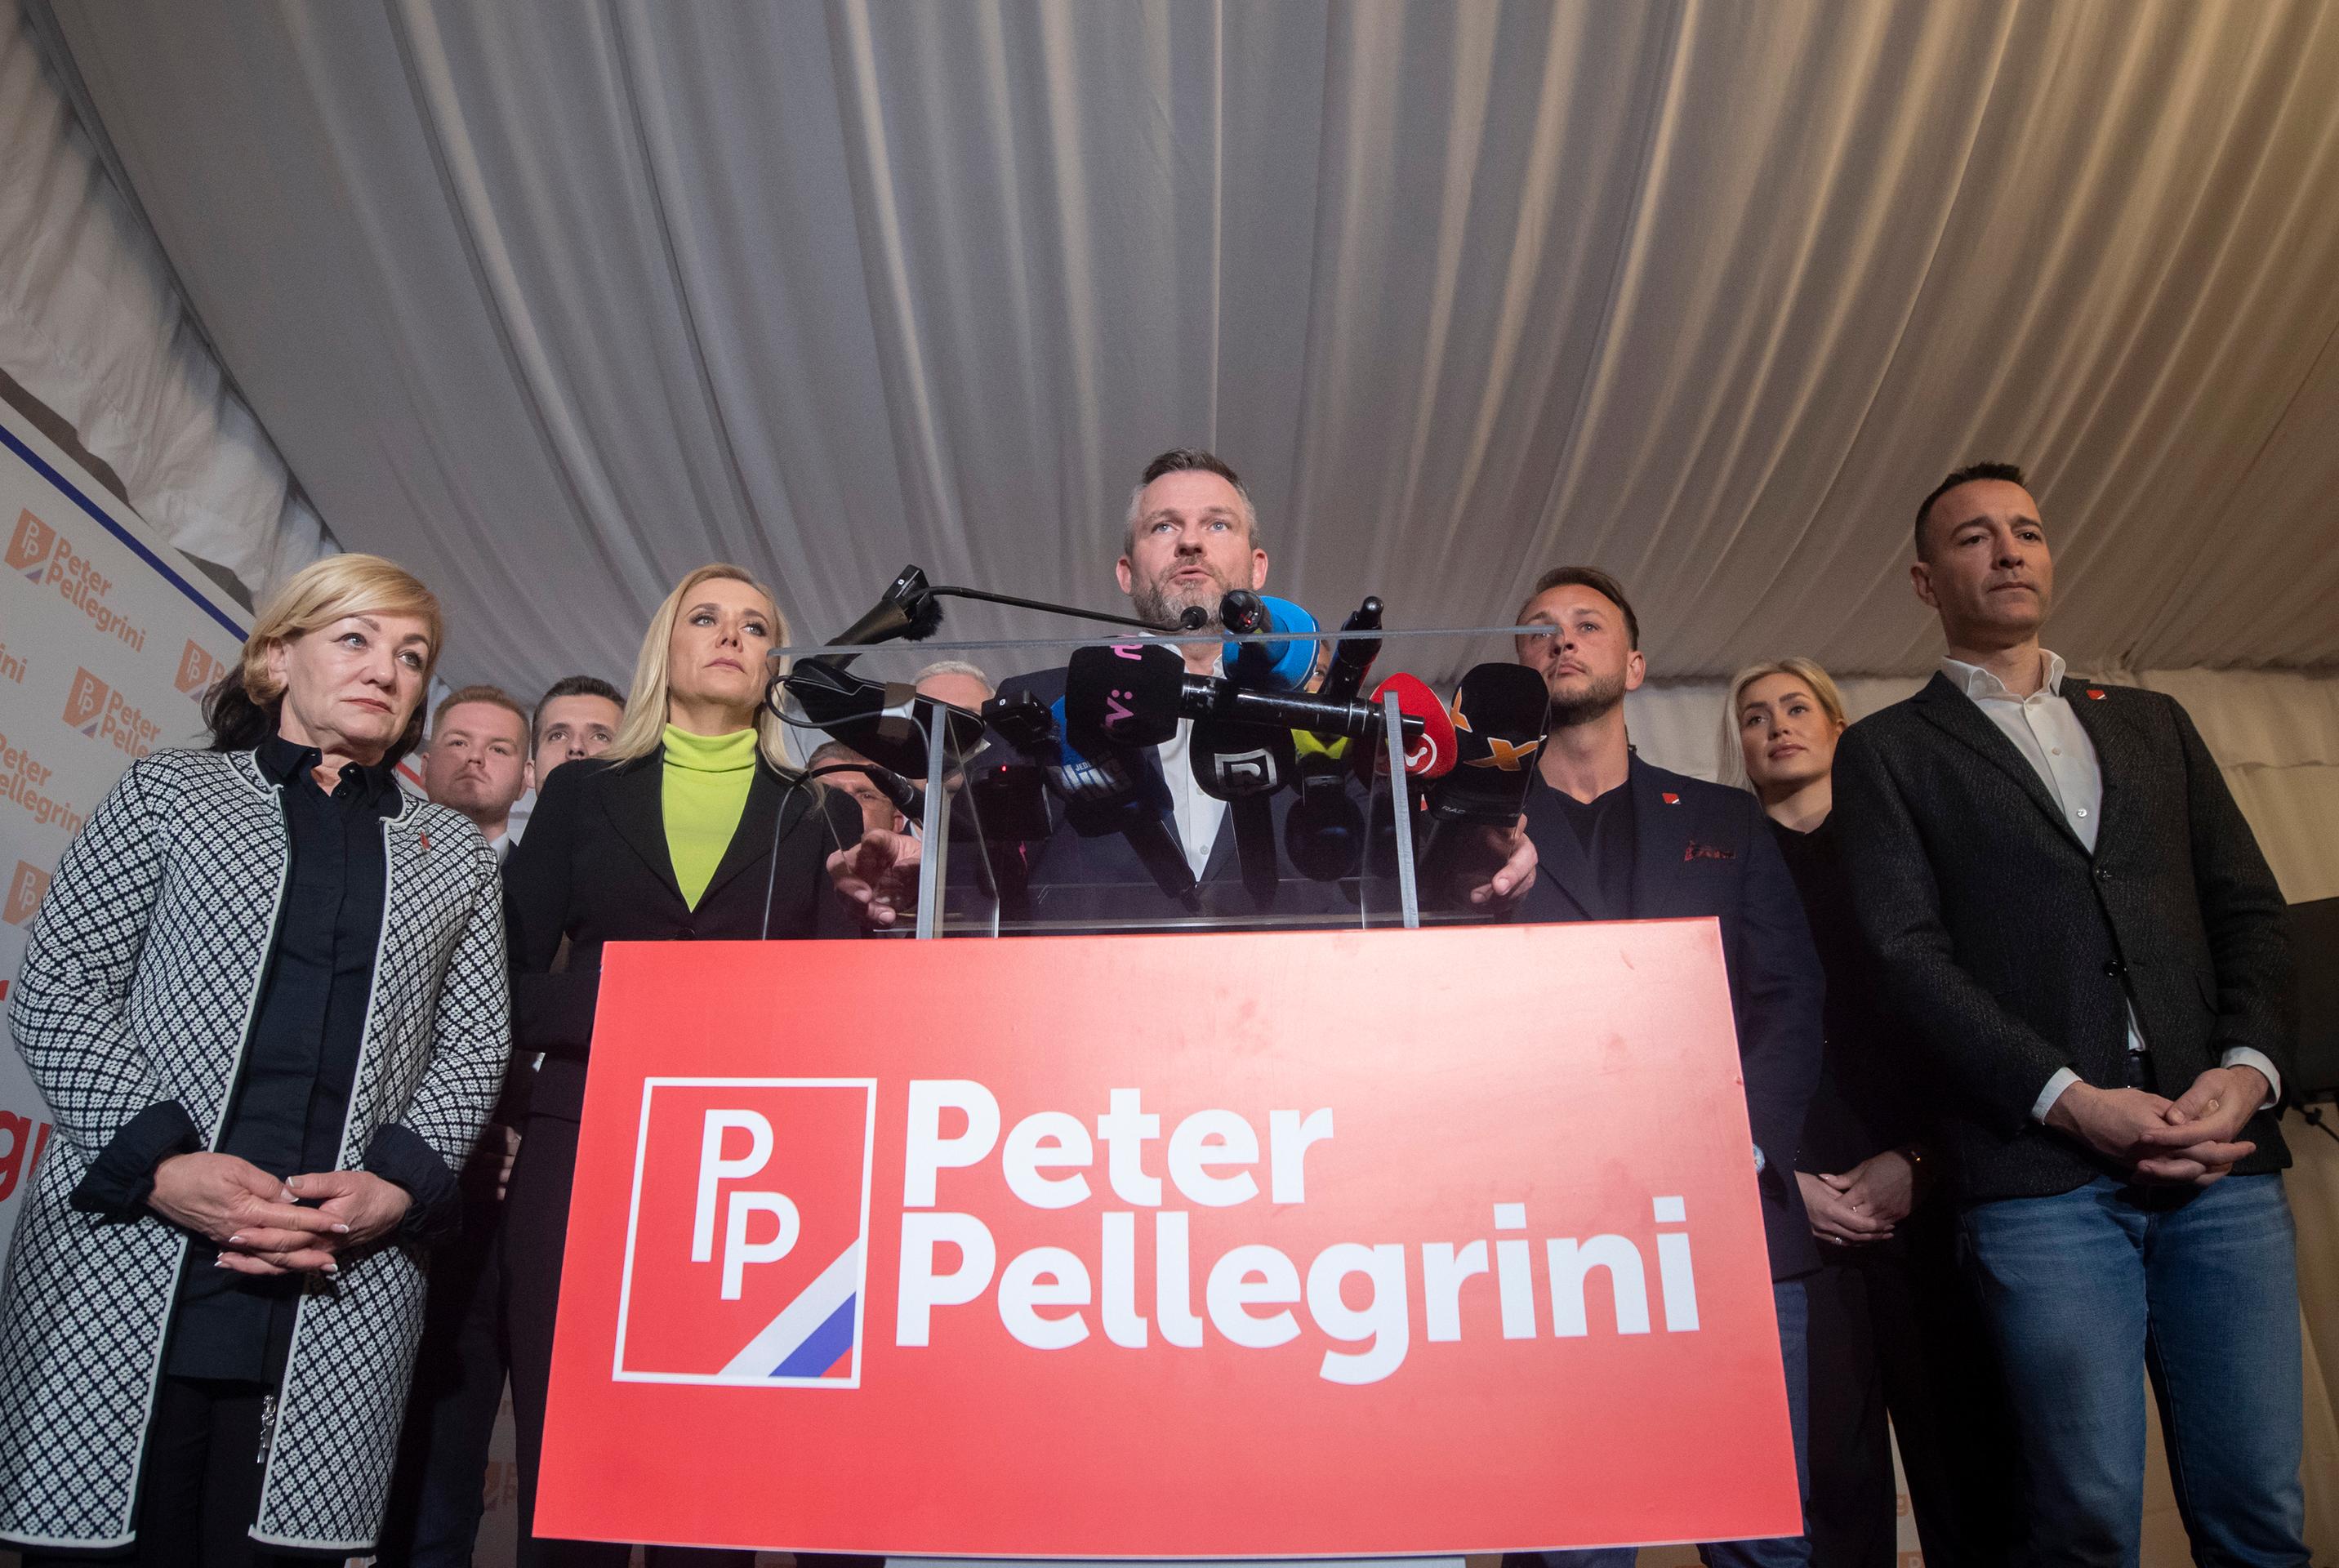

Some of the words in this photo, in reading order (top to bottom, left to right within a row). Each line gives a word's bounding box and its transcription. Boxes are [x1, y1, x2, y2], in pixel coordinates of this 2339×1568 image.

[53, 537, 112, 596] Peter
[45, 560, 145, 653] Pellegrini
[100, 713, 150, 759] Pelle
[107, 690, 162, 742] Peter
[0, 773, 90, 837] ellegrin
[904, 1080, 1334, 1209] Peter
[897, 1196, 1699, 1384] Pellegrini
